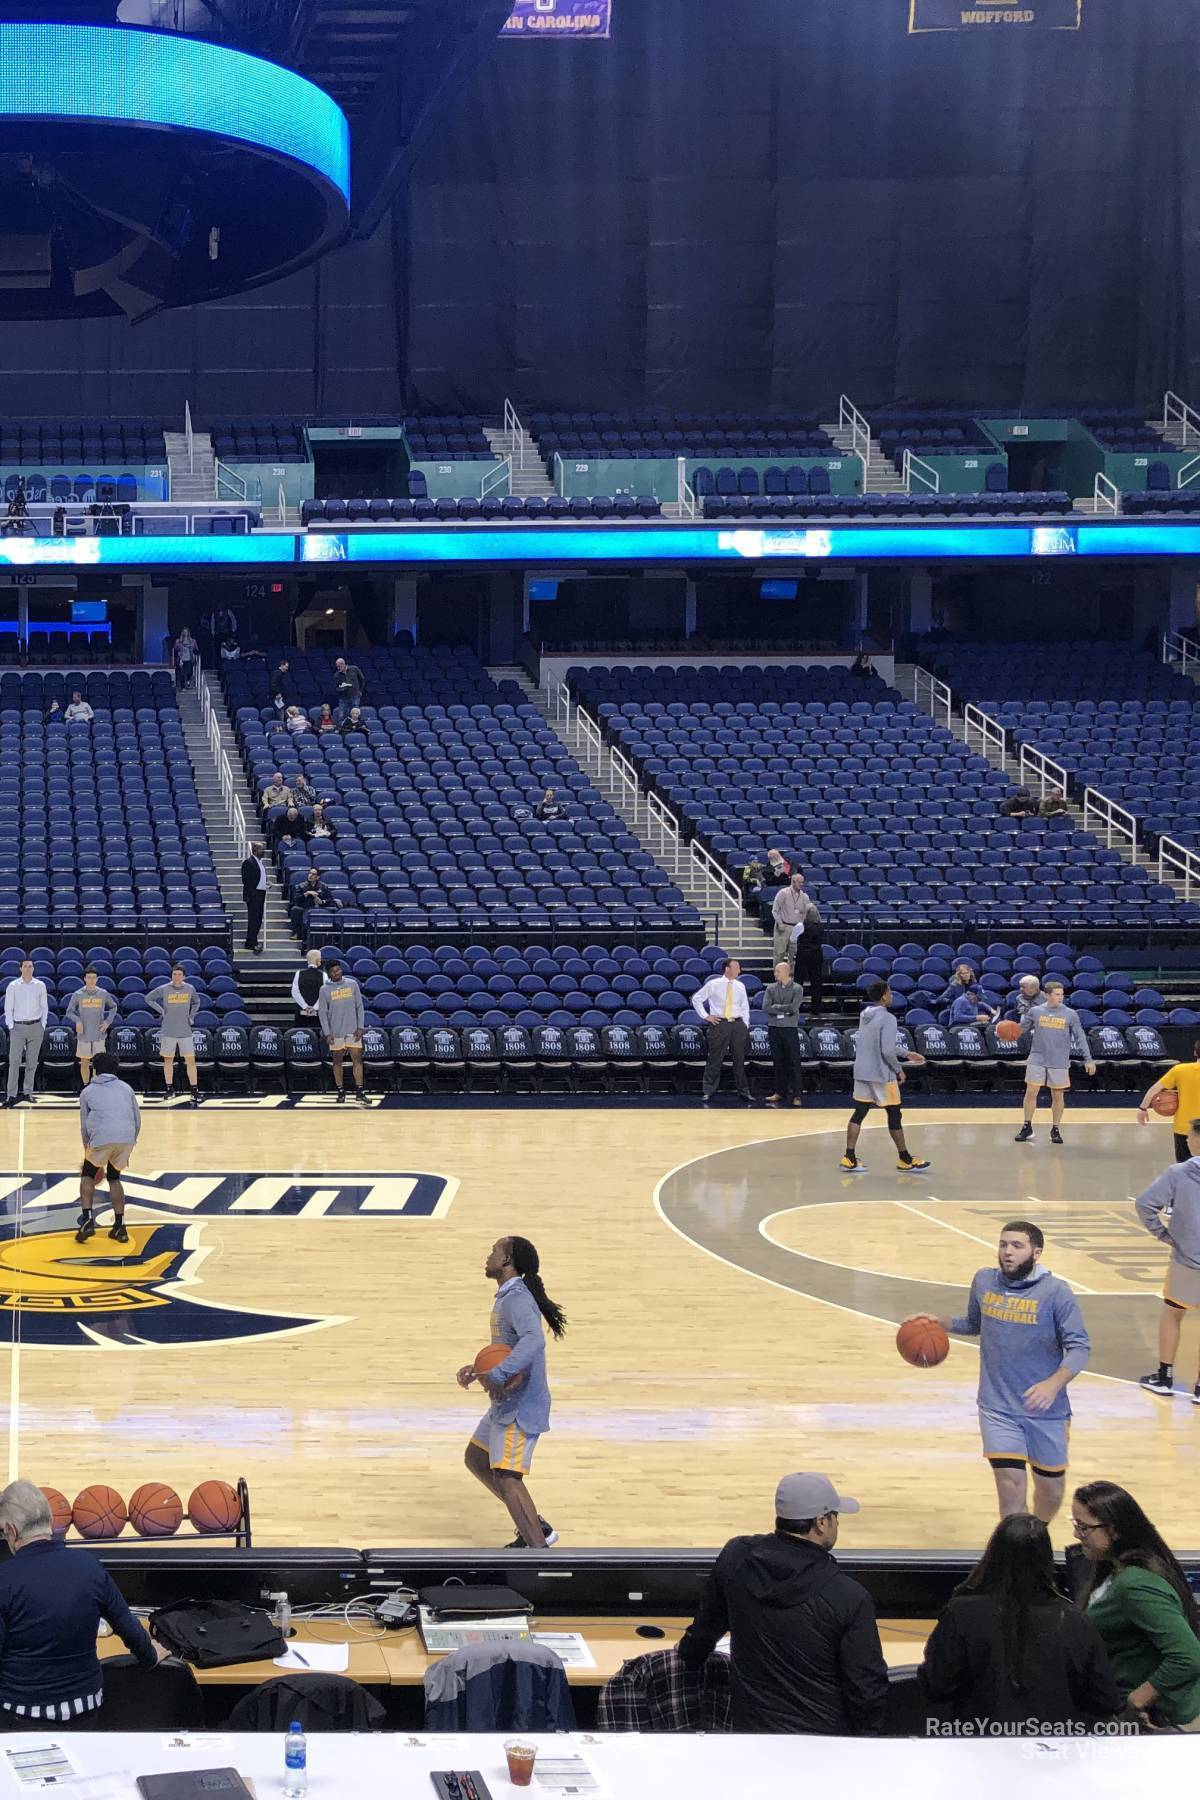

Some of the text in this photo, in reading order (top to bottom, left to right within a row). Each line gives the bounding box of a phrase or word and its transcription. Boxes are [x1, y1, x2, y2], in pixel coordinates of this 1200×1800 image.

[960, 10, 1034, 24] WOFFORD
[527, 15, 600, 28] CAROLINA
[117, 1042, 137, 1050] 1808
[222, 1042, 242, 1050] 1808
[256, 1042, 277, 1051] 1808
[292, 1044, 312, 1052] 1808
[364, 1043, 385, 1051] 1808
[400, 1042, 420, 1051] 1808
[434, 1044, 455, 1052] 1808
[470, 1043, 491, 1051] 1808
[505, 1042, 526, 1050] 1808
[541, 1041, 562, 1050] 1808
[575, 1043, 596, 1051] 1808
[610, 1041, 630, 1049] 1808
[646, 1041, 666, 1050] 1808
[680, 1041, 701, 1050] 1808
[820, 1042, 840, 1050] 1808
[960, 1042, 980, 1050] 1808
[996, 1041, 1018, 1049] 1808
[1102, 1040, 1123, 1049] 1808
[1138, 1041, 1159, 1050] 1808
